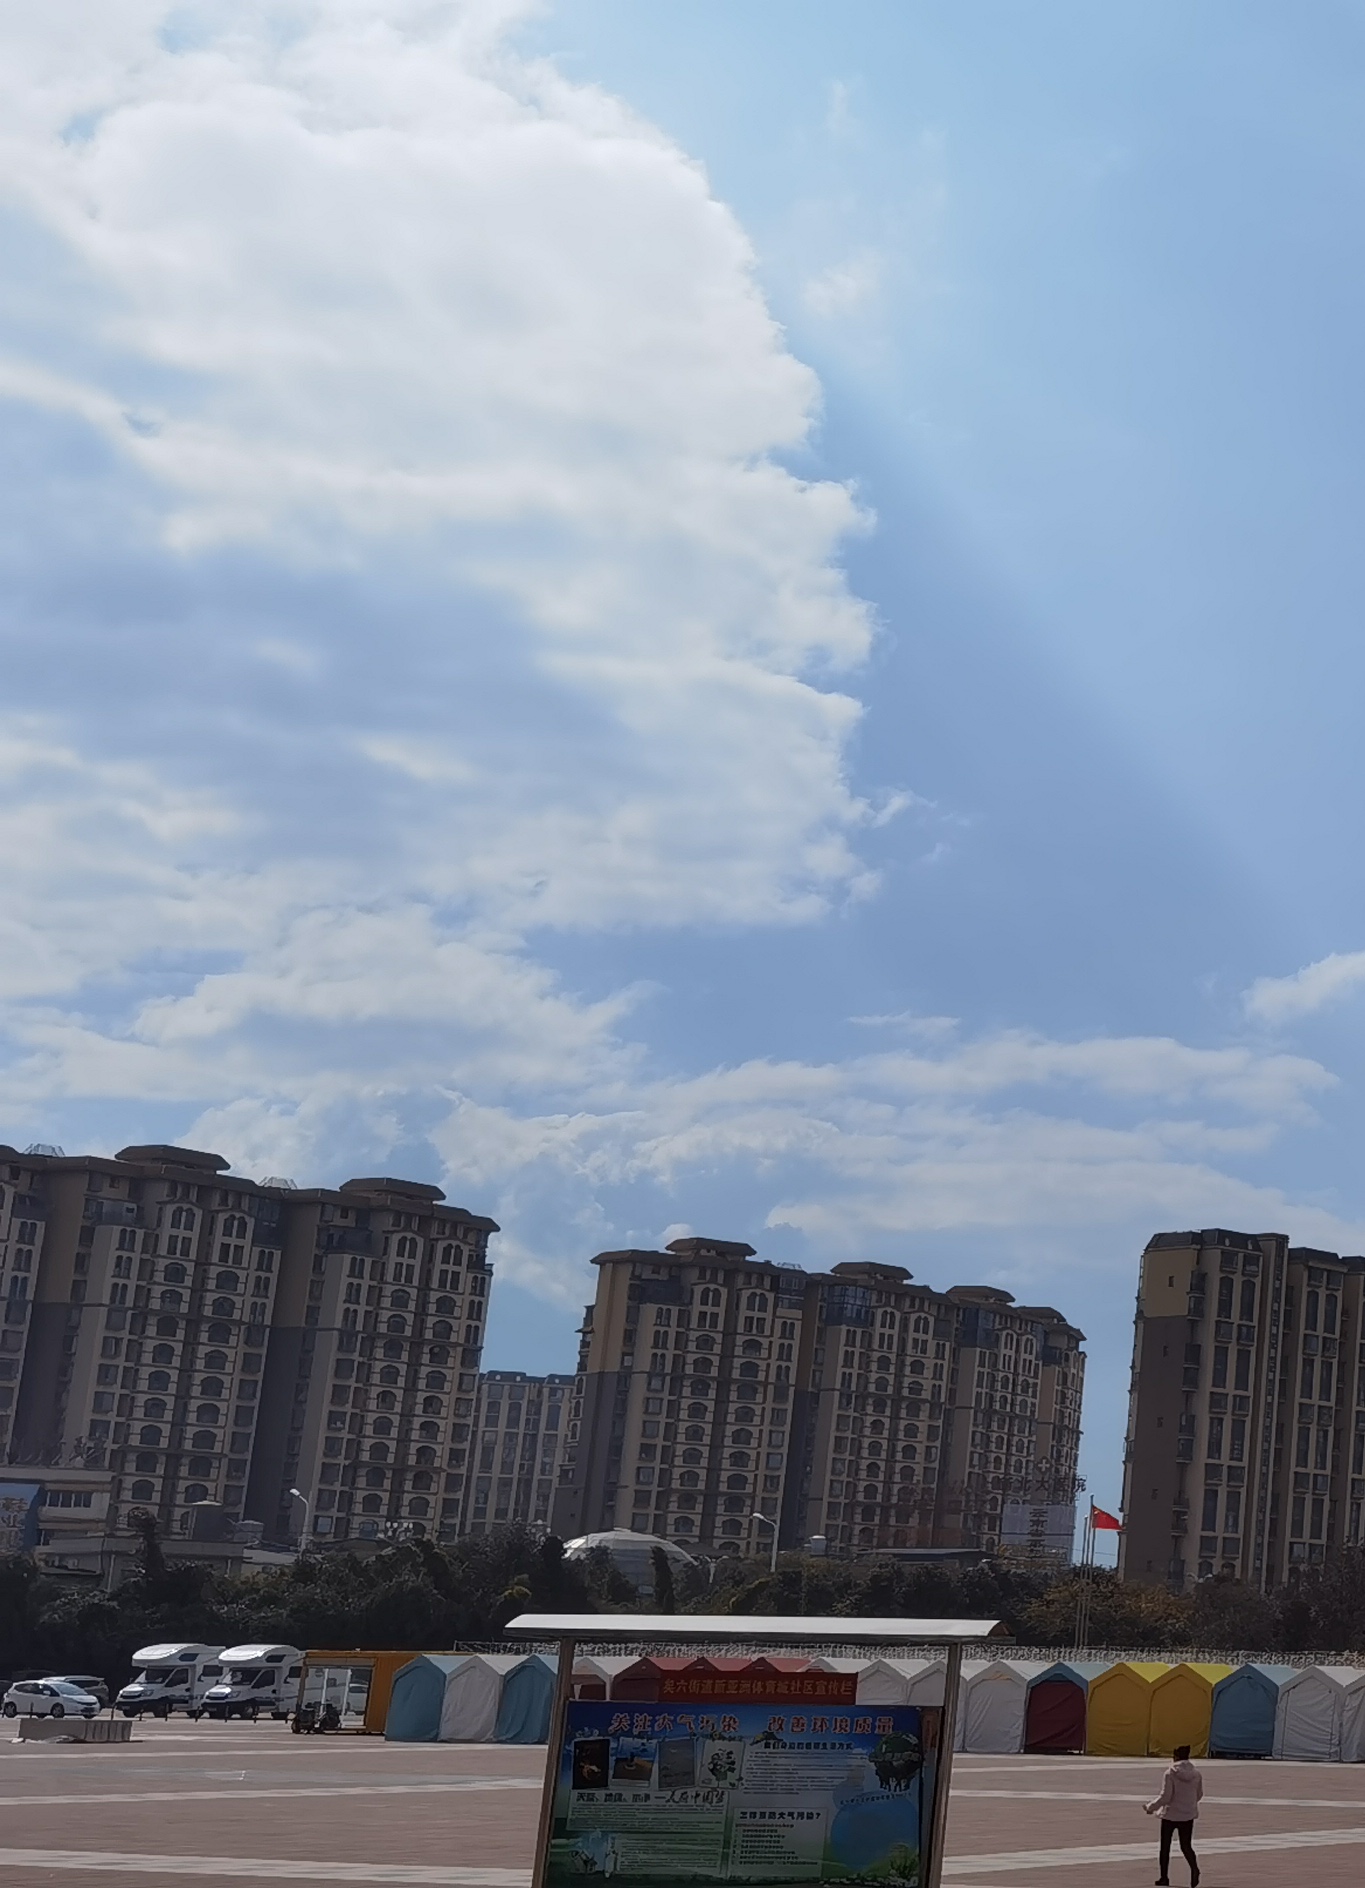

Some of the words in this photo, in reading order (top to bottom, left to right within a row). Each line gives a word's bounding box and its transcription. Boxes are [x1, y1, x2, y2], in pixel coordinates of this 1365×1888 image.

[608, 1712, 740, 1734] 关注大气污染
[767, 1715, 895, 1735] 改善环境质量
